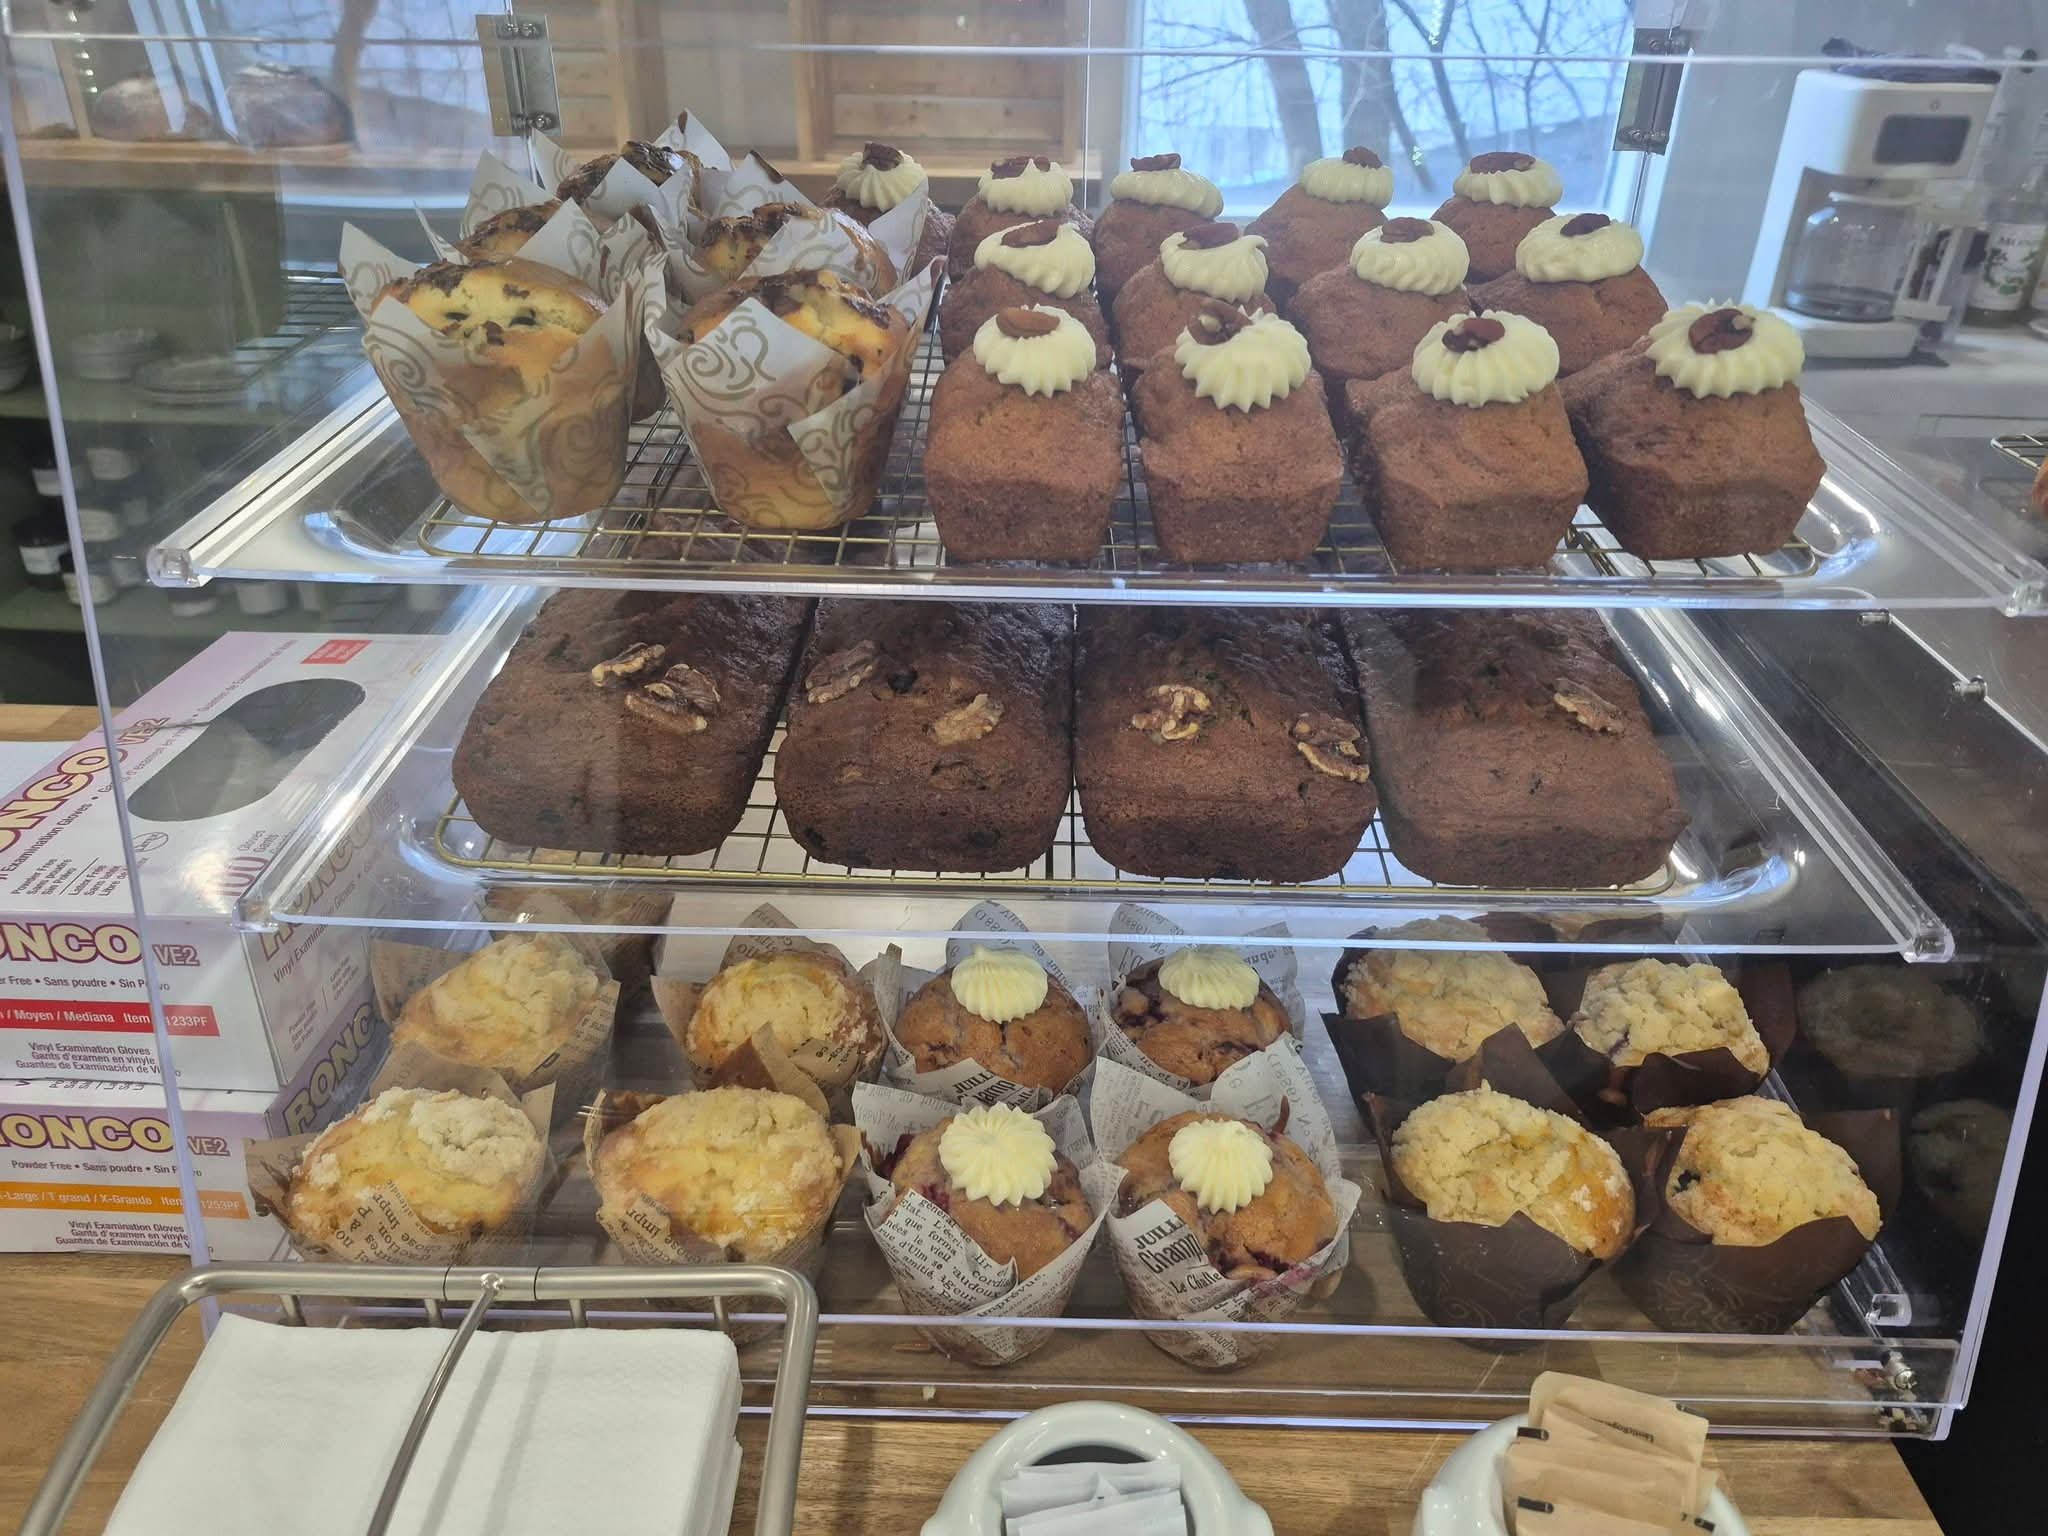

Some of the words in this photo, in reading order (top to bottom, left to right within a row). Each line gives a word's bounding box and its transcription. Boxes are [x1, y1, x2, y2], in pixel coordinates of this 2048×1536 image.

[152, 944, 200, 967] VE2
[9, 976, 32, 986] Free
[43, 977, 69, 987] Sans
[72, 978, 108, 990] poudre
[119, 979, 135, 989] Sin
[14, 1010, 55, 1023] Moyen
[63, 1011, 115, 1023] Mediana
[123, 1012, 151, 1025] Item
[56, 1043, 115, 1055] Examination
[117, 1045, 151, 1056] Gloves
[11, 1160, 48, 1170] Powder
[50, 1160, 72, 1170] Free
[83, 1162, 107, 1172] Sans
[109, 1164, 143, 1175] poudre
[154, 1165, 170, 1174] Sin
[95, 1221, 151, 1232] Examination
